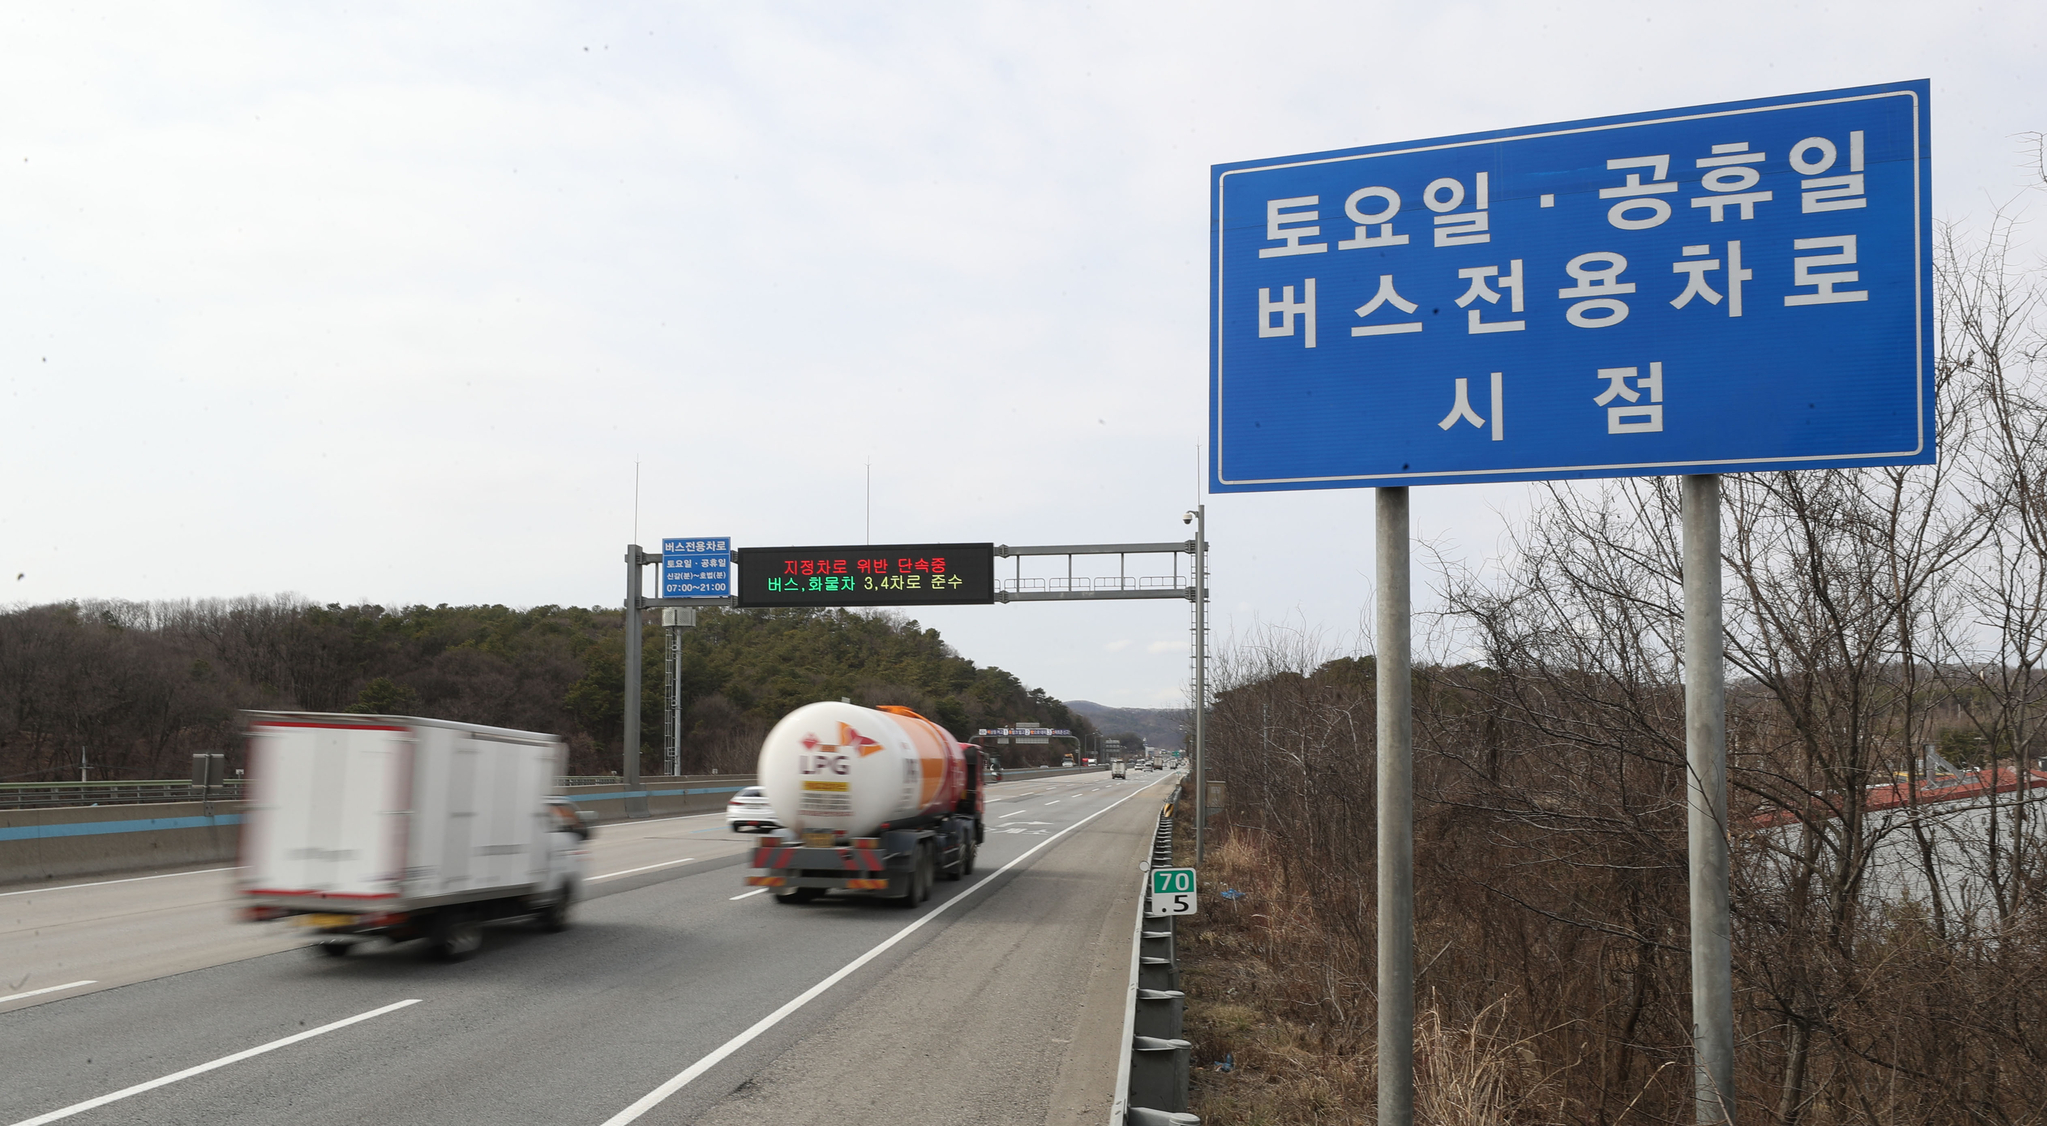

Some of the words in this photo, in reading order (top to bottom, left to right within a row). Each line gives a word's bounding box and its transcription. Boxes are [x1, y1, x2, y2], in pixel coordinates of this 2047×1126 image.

[1258, 171, 1491, 259] 토요일
[1598, 130, 1868, 231] 공휴일
[665, 541, 726, 552] 버스전용차로
[666, 559, 692, 568] 토요일
[701, 558, 726, 567] 공휴일
[784, 559, 848, 576] 지정차로
[856, 558, 889, 574] 위반
[897, 557, 946, 574] 단속중
[666, 583, 726, 592] 07:00~21:00
[768, 575, 856, 593] 버스,화물차
[863, 574, 922, 591] 3,4차로
[930, 573, 963, 590] 준수
[799, 754, 851, 776] LPG
[1159, 872, 1190, 892] 70
